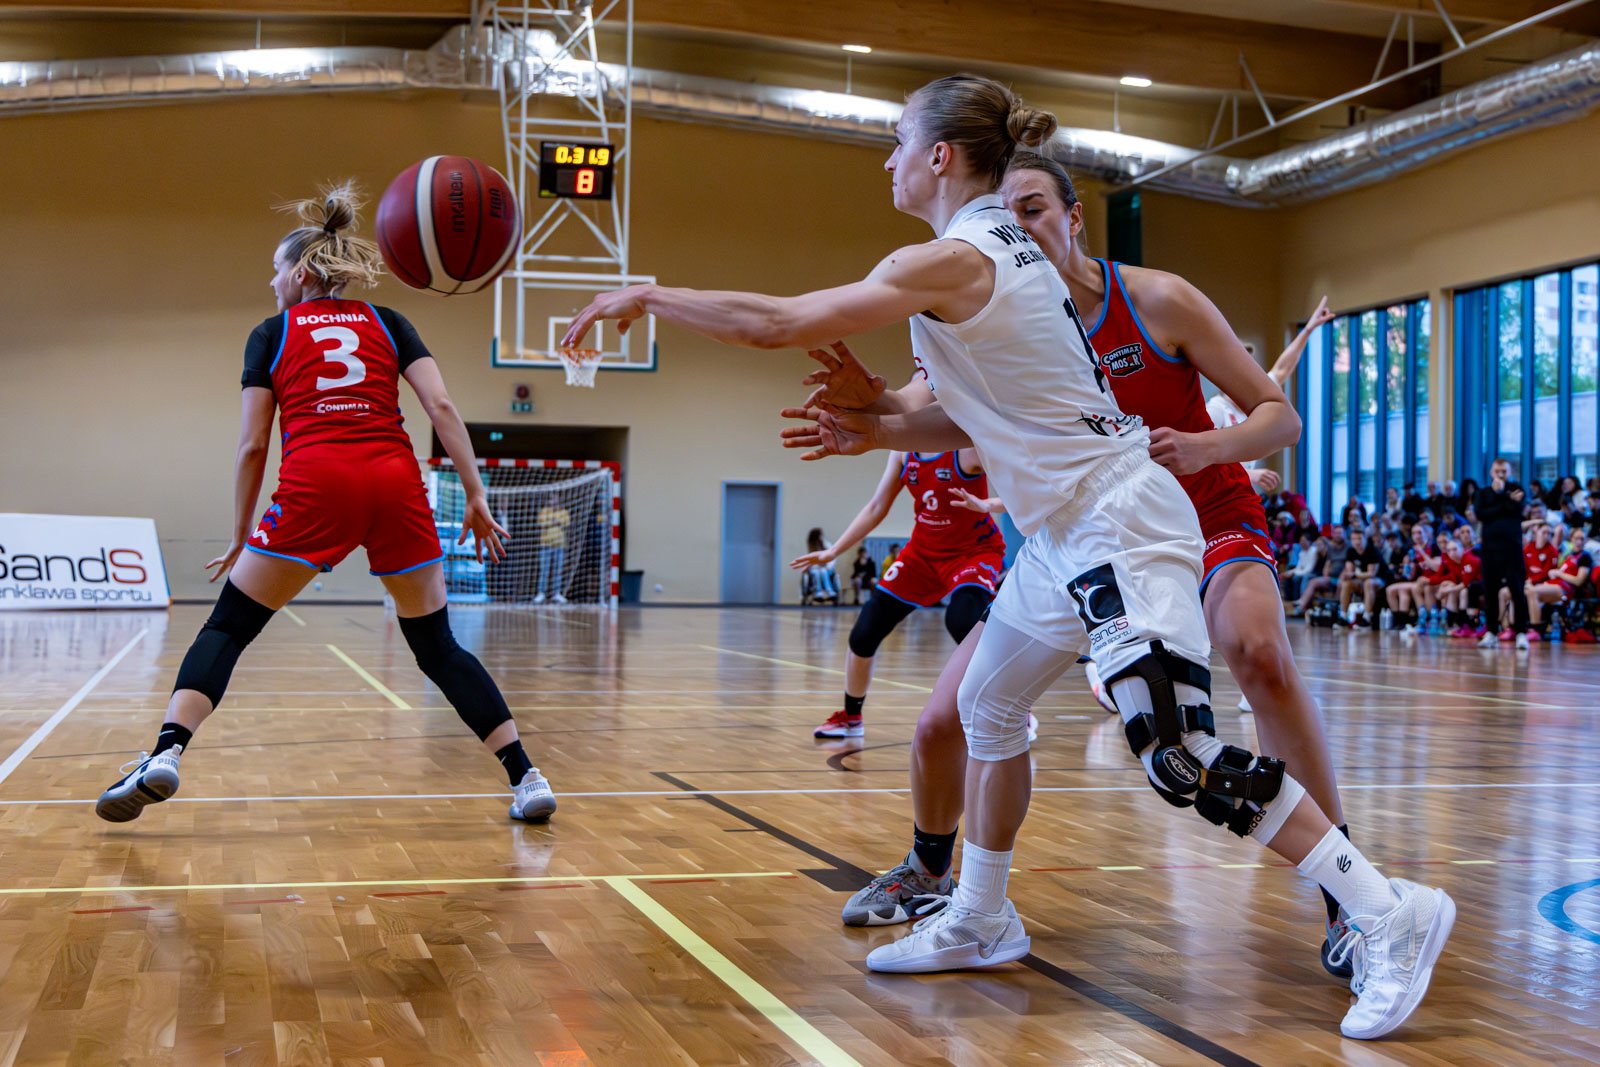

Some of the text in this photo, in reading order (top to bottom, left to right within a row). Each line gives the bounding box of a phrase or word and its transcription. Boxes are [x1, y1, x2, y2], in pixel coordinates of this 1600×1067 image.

[576, 169, 595, 194] 8
[449, 171, 464, 232] molten
[296, 313, 369, 325] BOCHNIA
[310, 326, 367, 391] 3
[317, 403, 370, 413] CONTIMAX
[922, 489, 939, 511] 6
[0, 543, 147, 584] andS
[883, 561, 904, 581] 6
[0, 584, 152, 603] nklawa sportu
